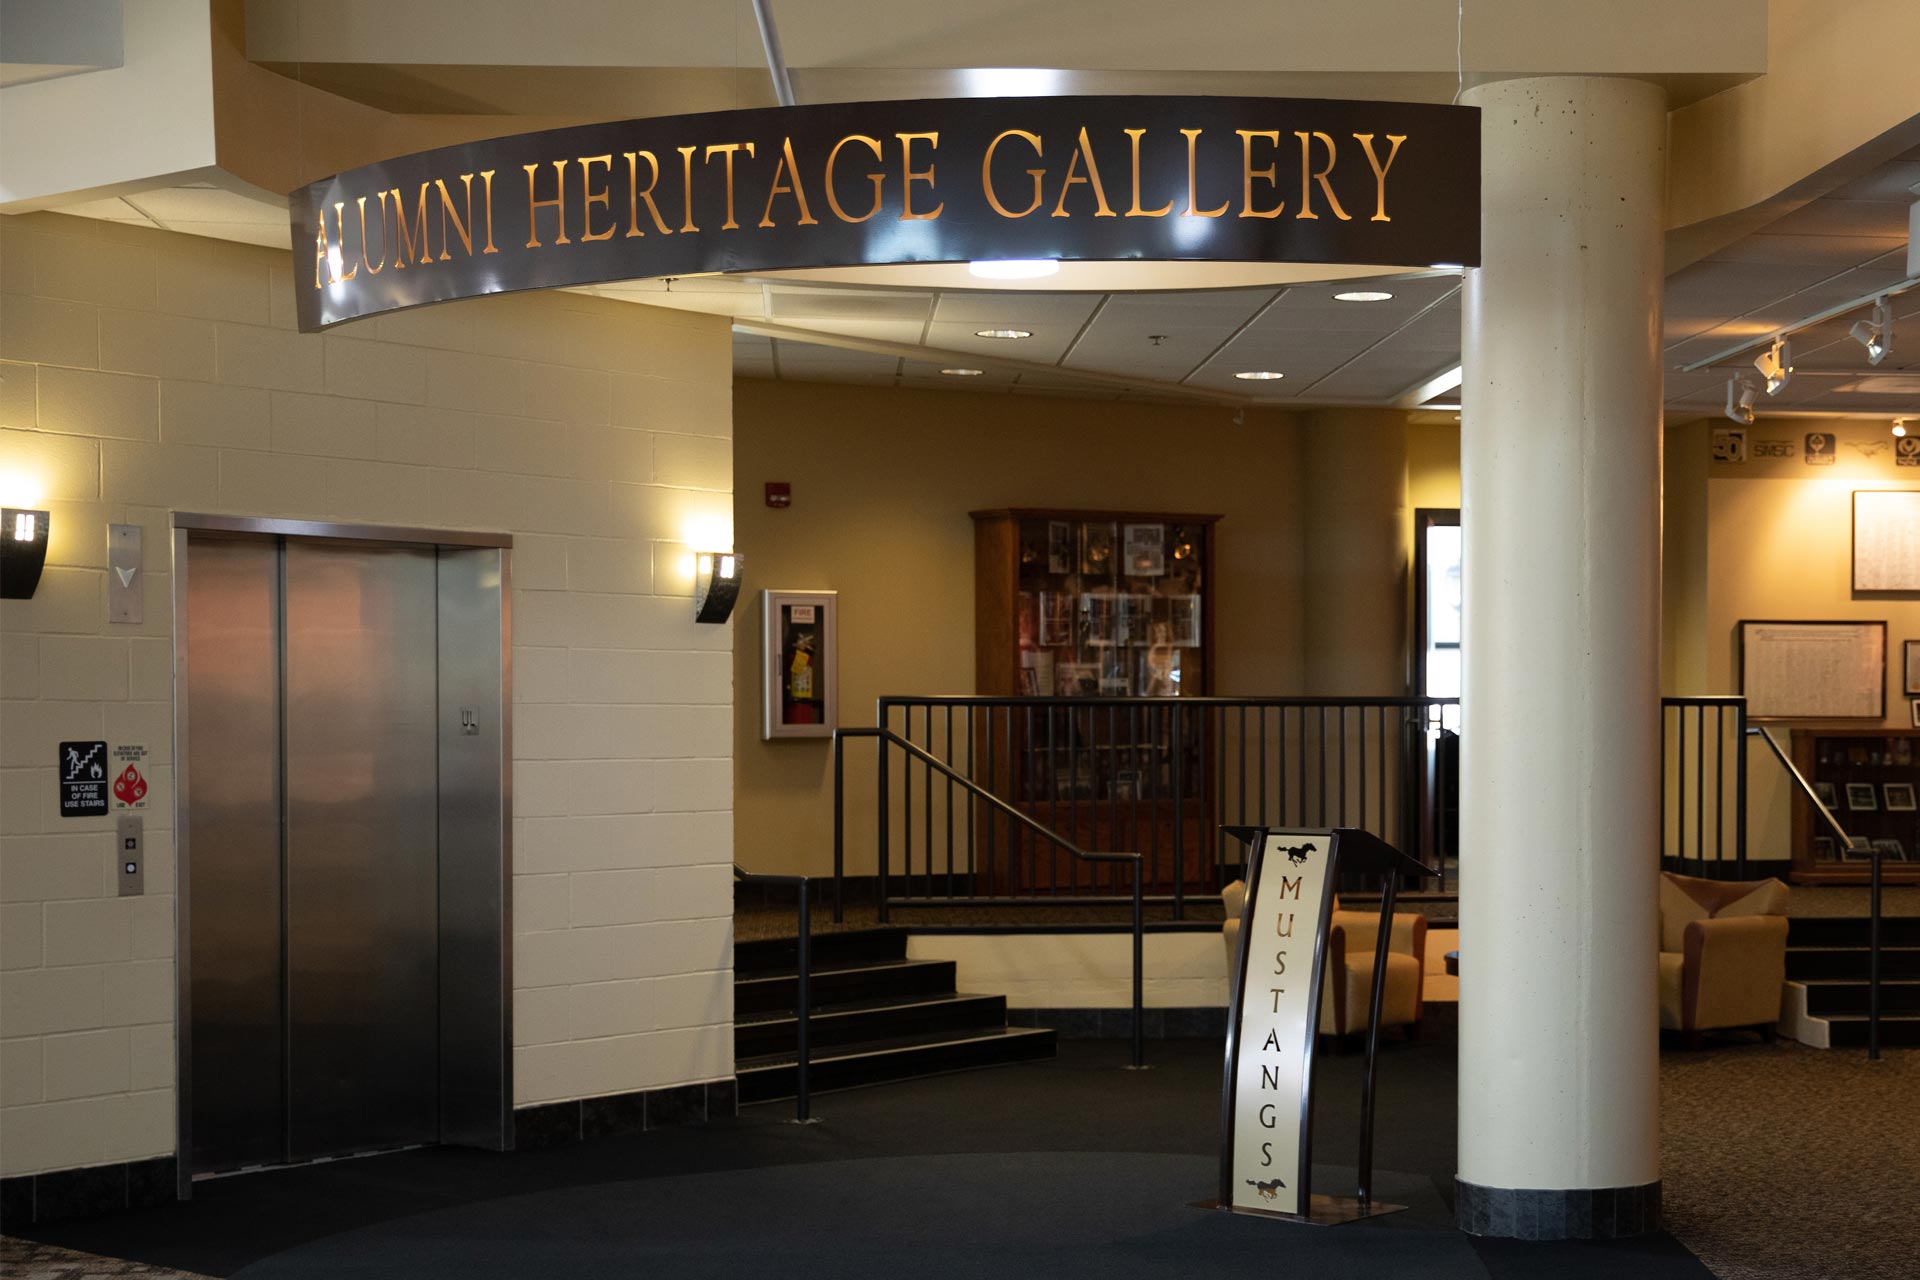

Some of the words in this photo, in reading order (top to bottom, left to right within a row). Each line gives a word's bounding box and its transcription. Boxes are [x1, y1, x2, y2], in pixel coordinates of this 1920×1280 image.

[313, 168, 499, 291] ALUMNI
[523, 130, 943, 250] HERITAGE
[981, 126, 1408, 224] GALLERY
[64, 800, 79, 808] USE
[1259, 876, 1302, 1166] MUSTANGS
